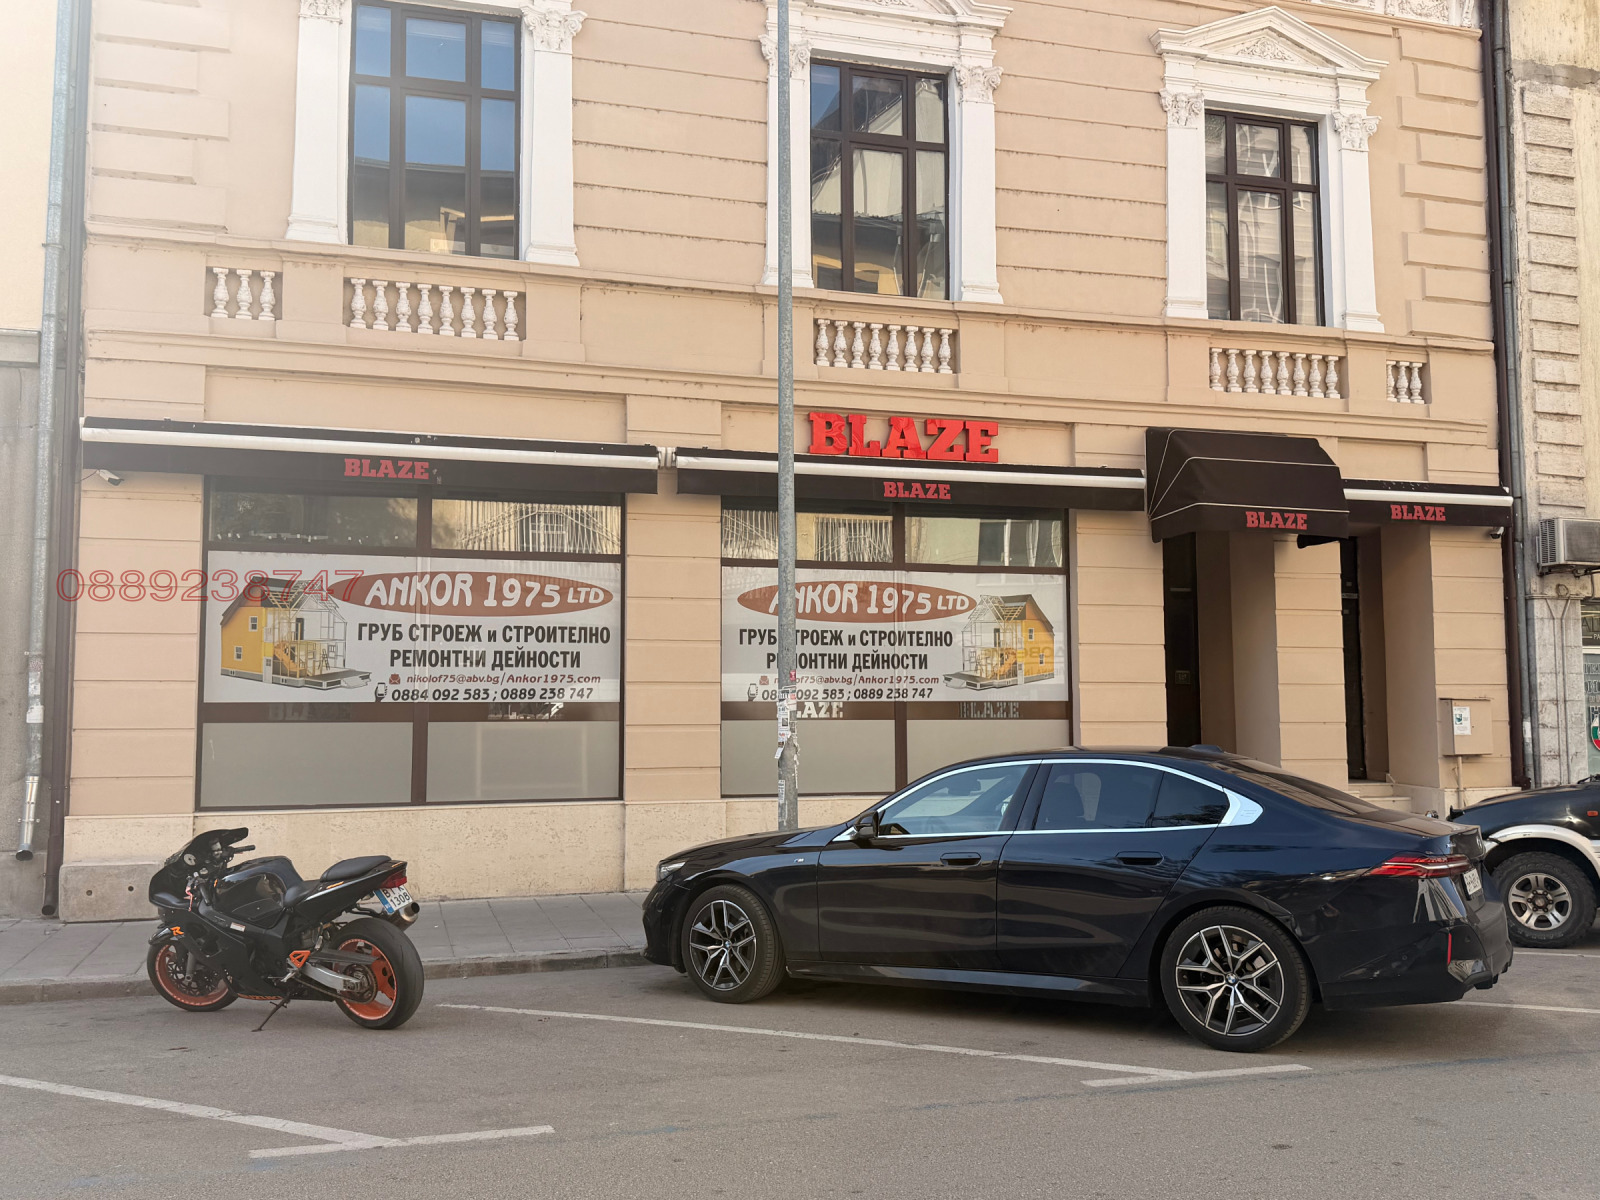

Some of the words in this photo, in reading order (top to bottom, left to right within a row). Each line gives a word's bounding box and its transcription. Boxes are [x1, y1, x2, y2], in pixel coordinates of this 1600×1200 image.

[808, 412, 999, 463] BLAZE
[344, 458, 429, 479] BLAZE
[883, 481, 951, 499] BLAZE
[1245, 511, 1307, 530] BLAZE
[1390, 504, 1446, 521] BLAZE
[364, 573, 473, 606] ANKOR
[483, 575, 561, 608] 1975
[567, 587, 605, 604] LTD
[866, 584, 931, 615] 1975
[937, 595, 970, 610] LTD
[357, 623, 403, 641] ГРУБ
[408, 624, 482, 642] СТРОЕЖ
[502, 625, 610, 644] СТРОИТЕЛНО
[739, 628, 777, 645] ГРУБ
[796, 629, 844, 646] ТРОЕЖ
[859, 630, 953, 647] СТРОИТЕЛНО
[390, 649, 486, 668] РЕМОНТНИ
[491, 646, 580, 671] ДЕЙНОСТИ
[767, 652, 847, 669] РОНТНИ
[852, 649, 928, 672] ДЕЙНОСТИ
[391, 689, 428, 701] 0884
[432, 689, 460, 701] 092
[539, 688, 565, 700] 238
[569, 687, 593, 699] 747
[796, 689, 819, 700] 092
[886, 688, 908, 699] 238
[912, 688, 933, 698] 747
[776, 701, 844, 719] AZE
[390, 892, 411, 908] 1308
